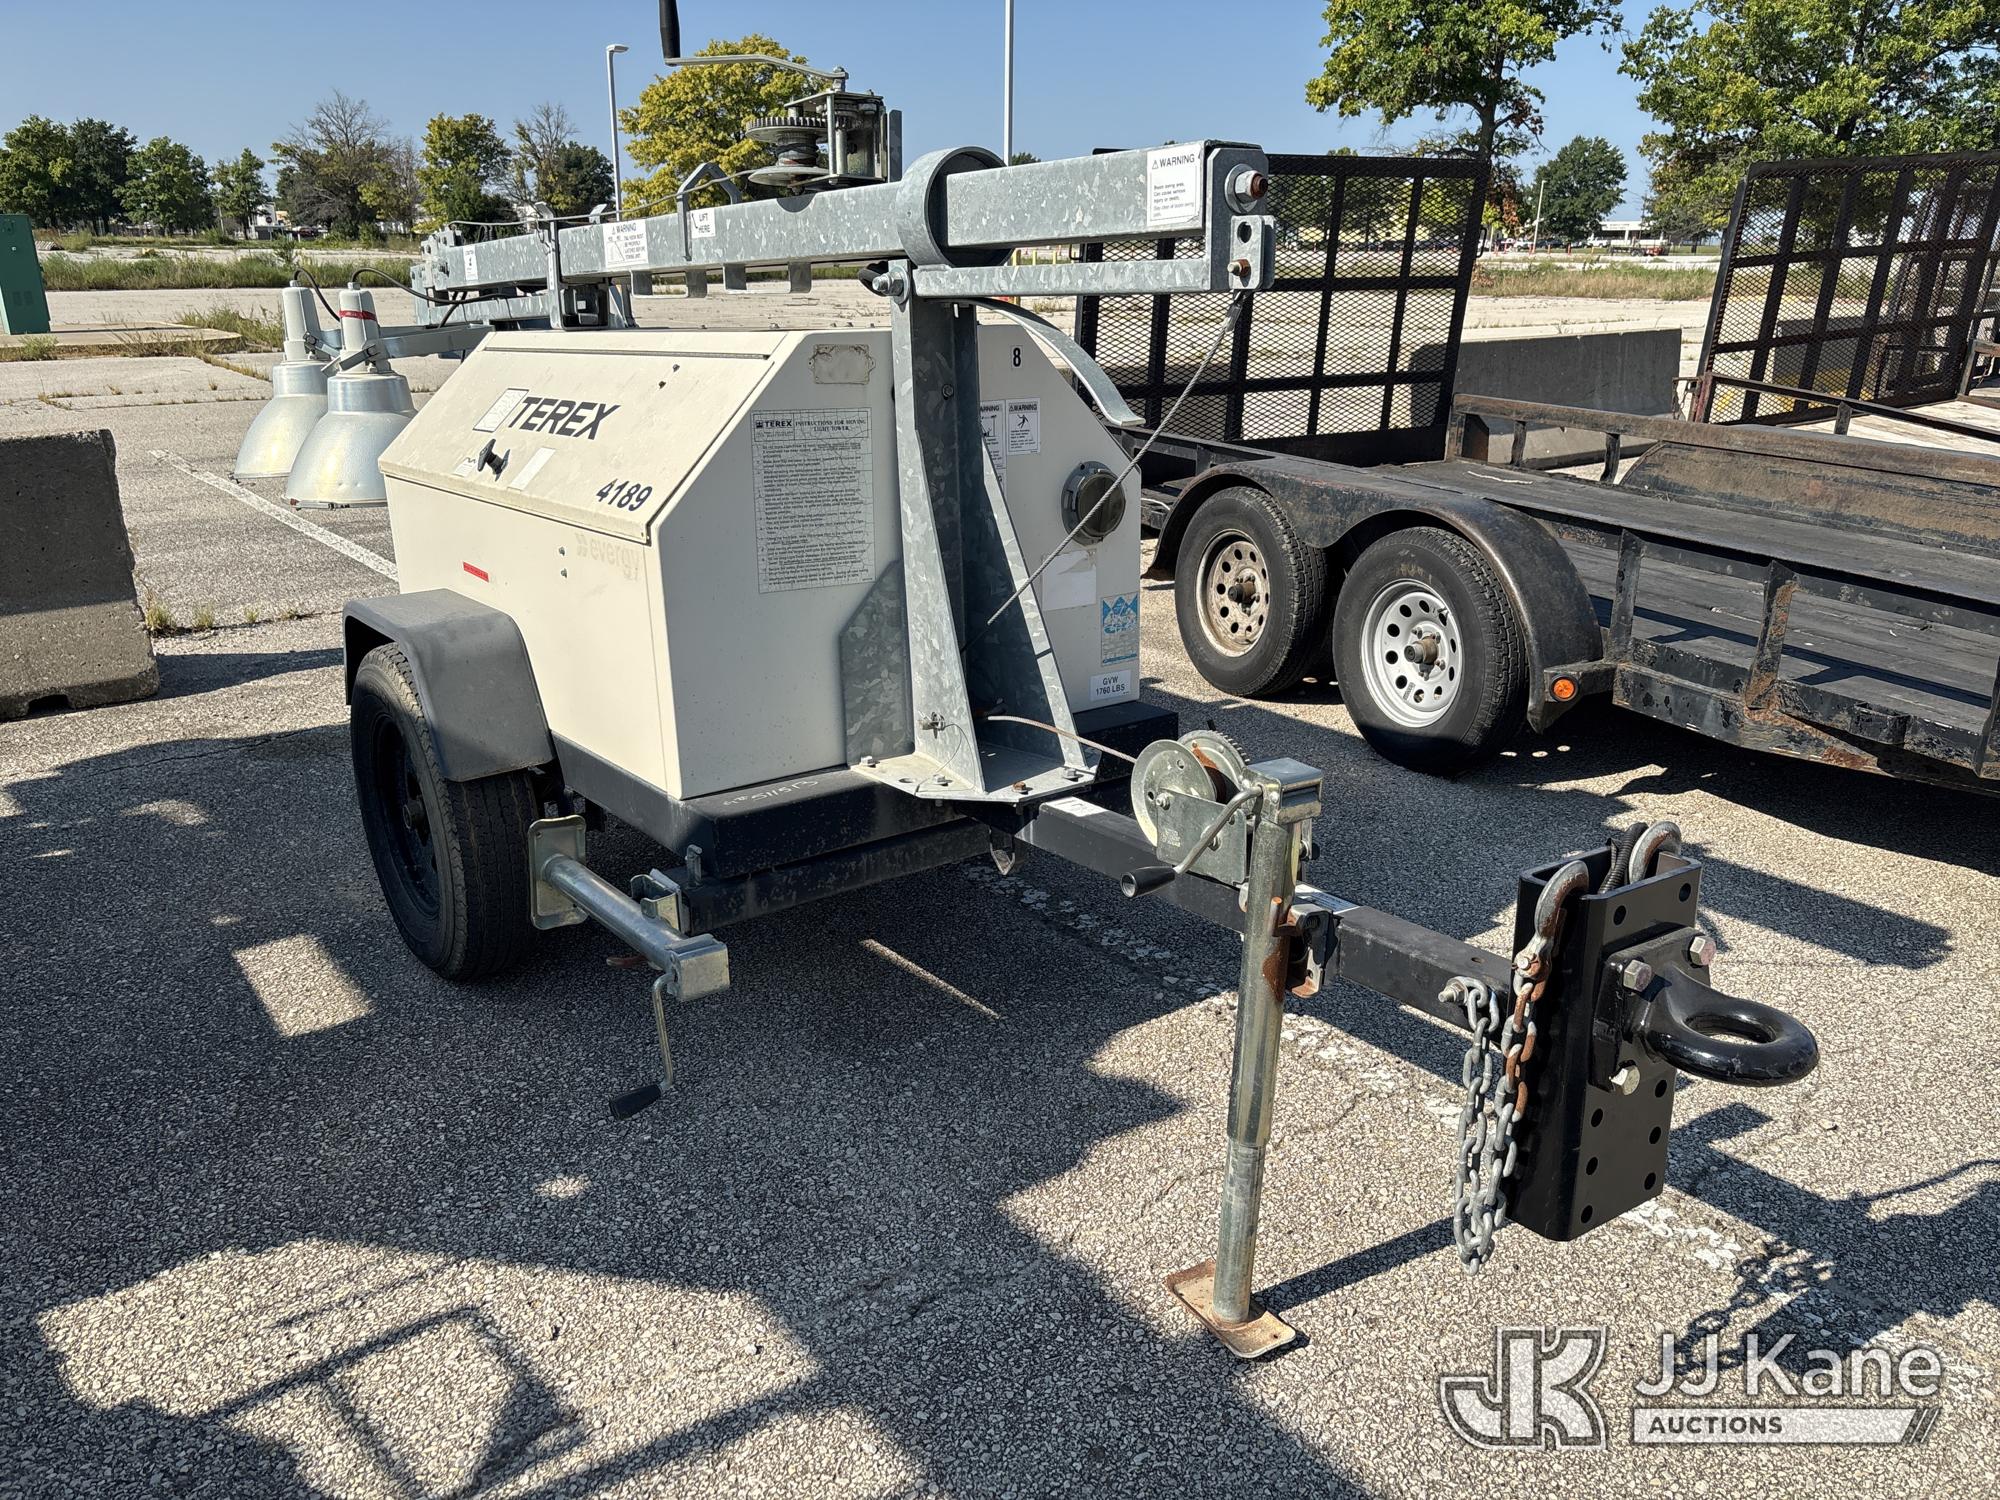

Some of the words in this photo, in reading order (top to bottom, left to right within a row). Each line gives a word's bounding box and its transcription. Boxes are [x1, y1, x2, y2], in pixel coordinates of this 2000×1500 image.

[1160, 153, 1195, 168] WARNING
[699, 212, 708, 222] LIFT
[616, 222, 636, 233] WARNING
[699, 224, 710, 233] HERE
[1013, 347, 1021, 367] 8
[1015, 403, 1038, 411] WARNING
[508, 396, 622, 441] TEREX
[765, 420, 792, 428] TEREX
[596, 478, 653, 511] 4189
[1102, 676, 1118, 685] GVW
[1096, 686, 1110, 696] 1760
[1111, 683, 1125, 693] LBS
